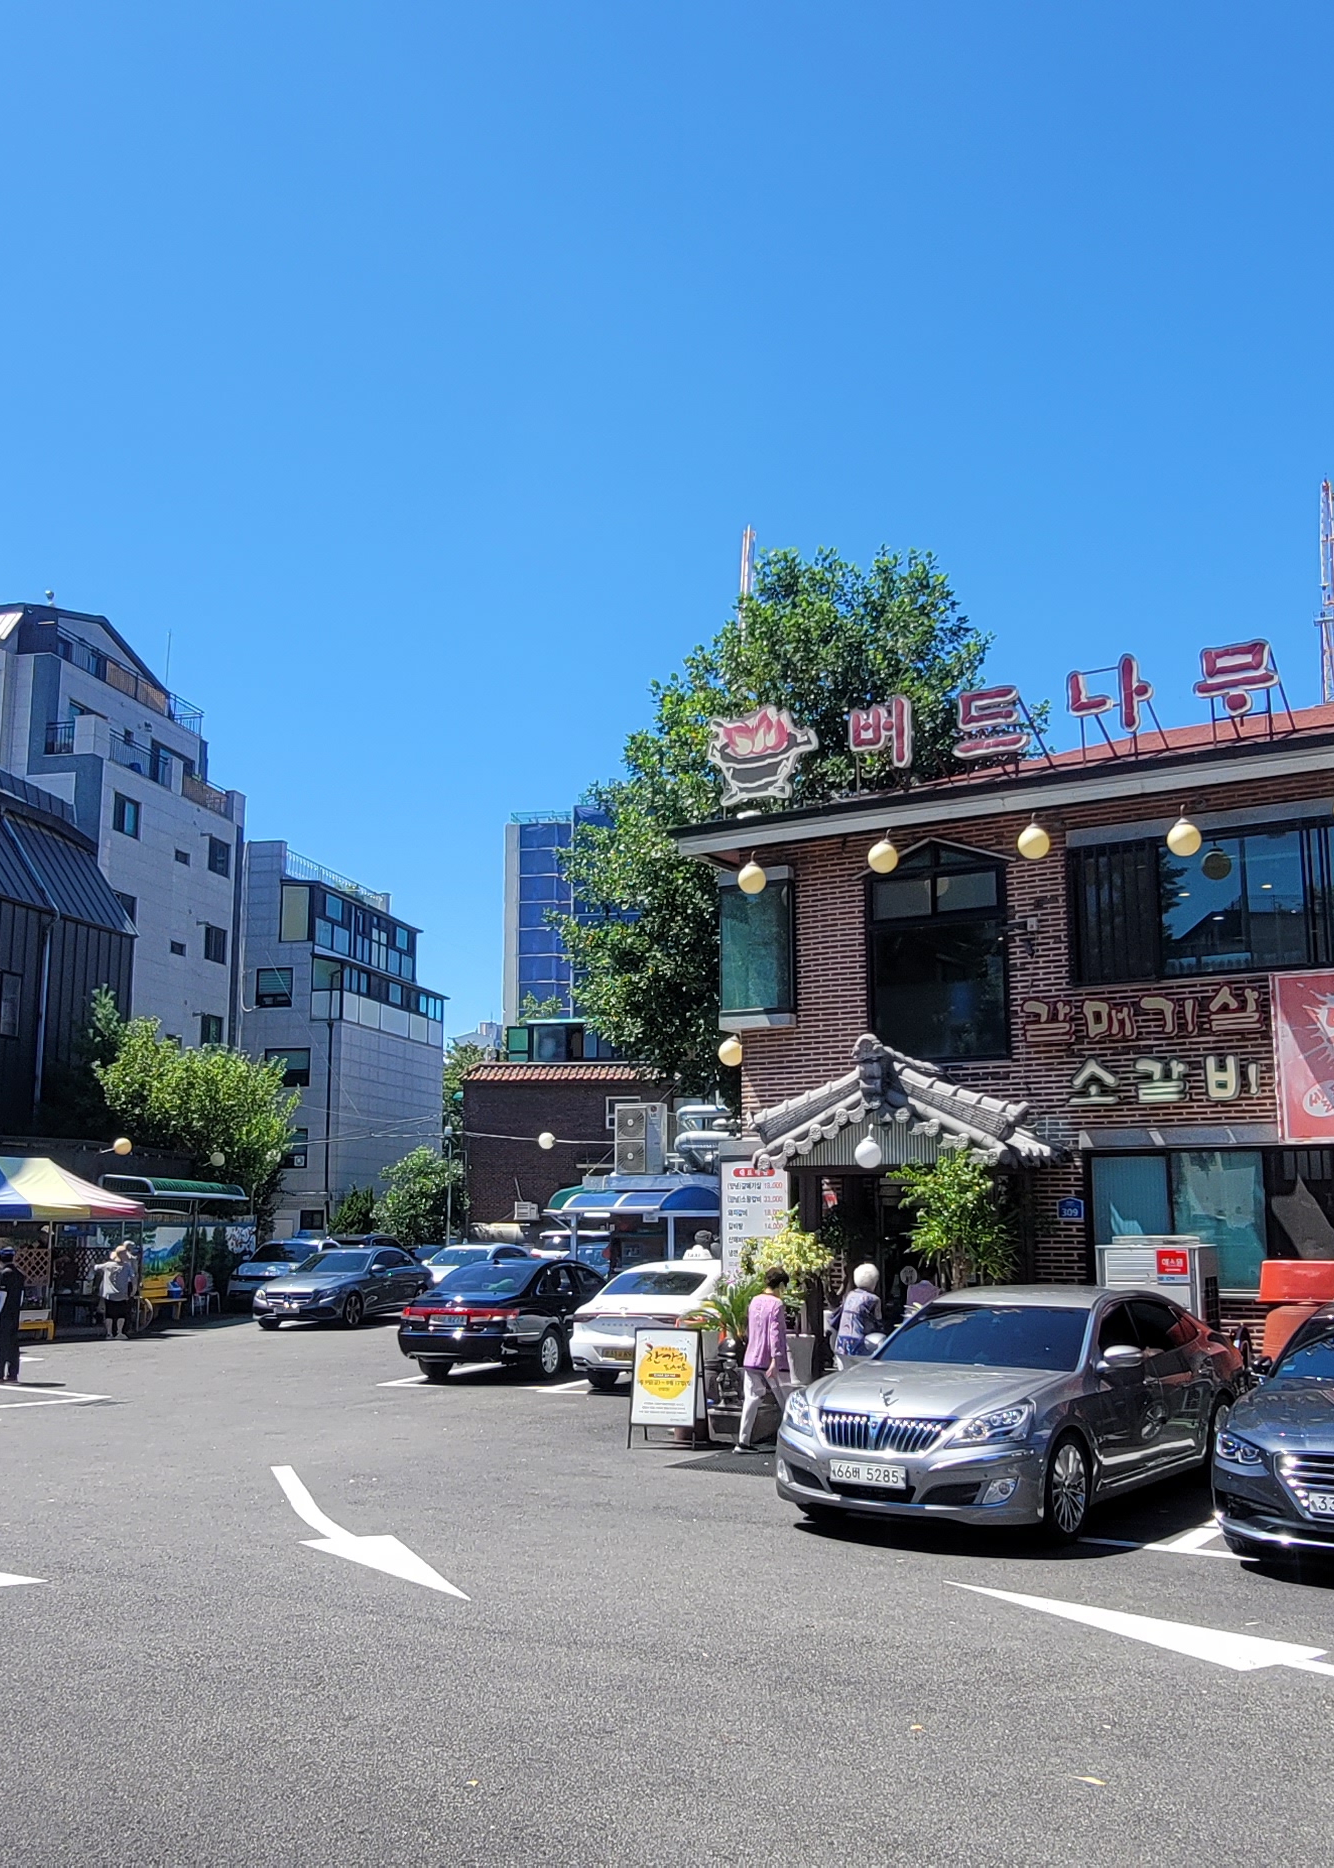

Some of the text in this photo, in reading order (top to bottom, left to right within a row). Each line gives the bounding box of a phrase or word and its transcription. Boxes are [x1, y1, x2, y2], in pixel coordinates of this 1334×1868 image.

[1021, 984, 1265, 1044] 갈매기살
[1067, 1054, 1260, 1105] 소갈비
[1061, 1208, 1078, 1217] 309
[866, 1467, 899, 1484] 5285
